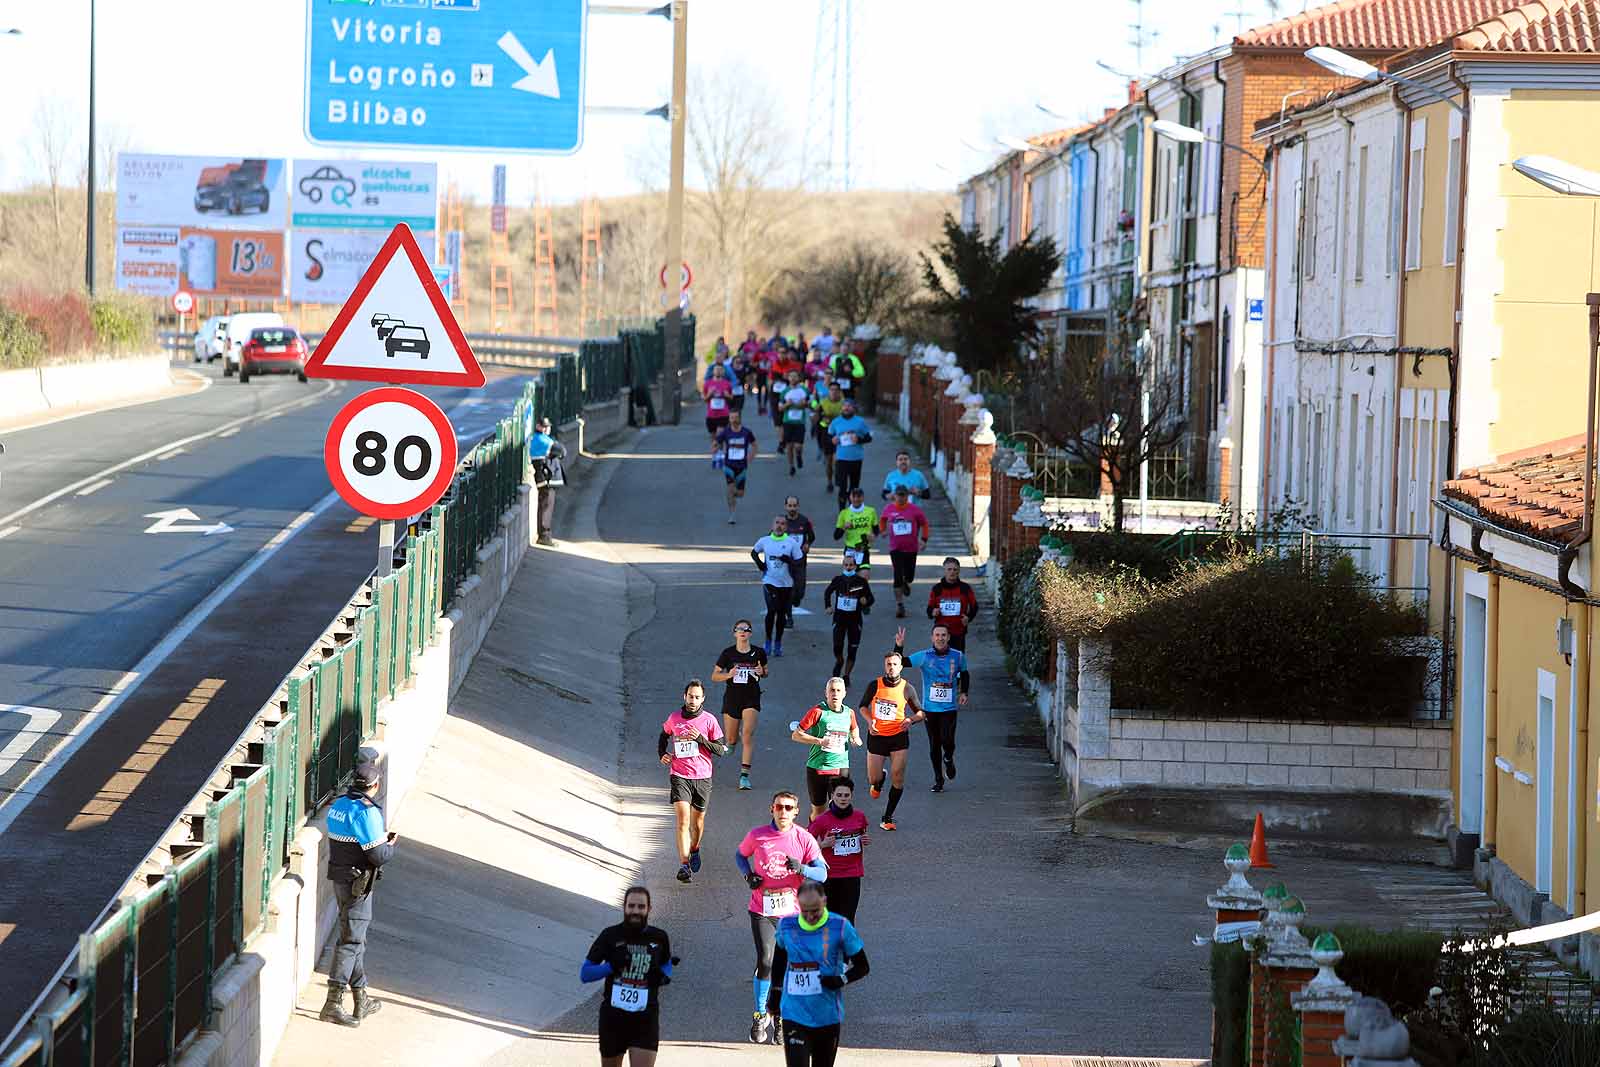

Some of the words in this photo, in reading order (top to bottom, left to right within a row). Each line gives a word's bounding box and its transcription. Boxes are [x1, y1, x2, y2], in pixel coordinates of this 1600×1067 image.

[332, 18, 442, 46] Vitoria
[329, 59, 456, 90] Logroño
[328, 100, 427, 126] Bilbao
[362, 167, 411, 180] elcoche
[362, 181, 430, 193] quebuscas
[353, 431, 432, 480] 80
[935, 689, 947, 698] 320
[680, 742, 692, 752] 217
[840, 838, 856, 848] 413
[630, 953, 652, 974] MIS
[794, 973, 811, 987] 491
[620, 988, 638, 1004] 529
